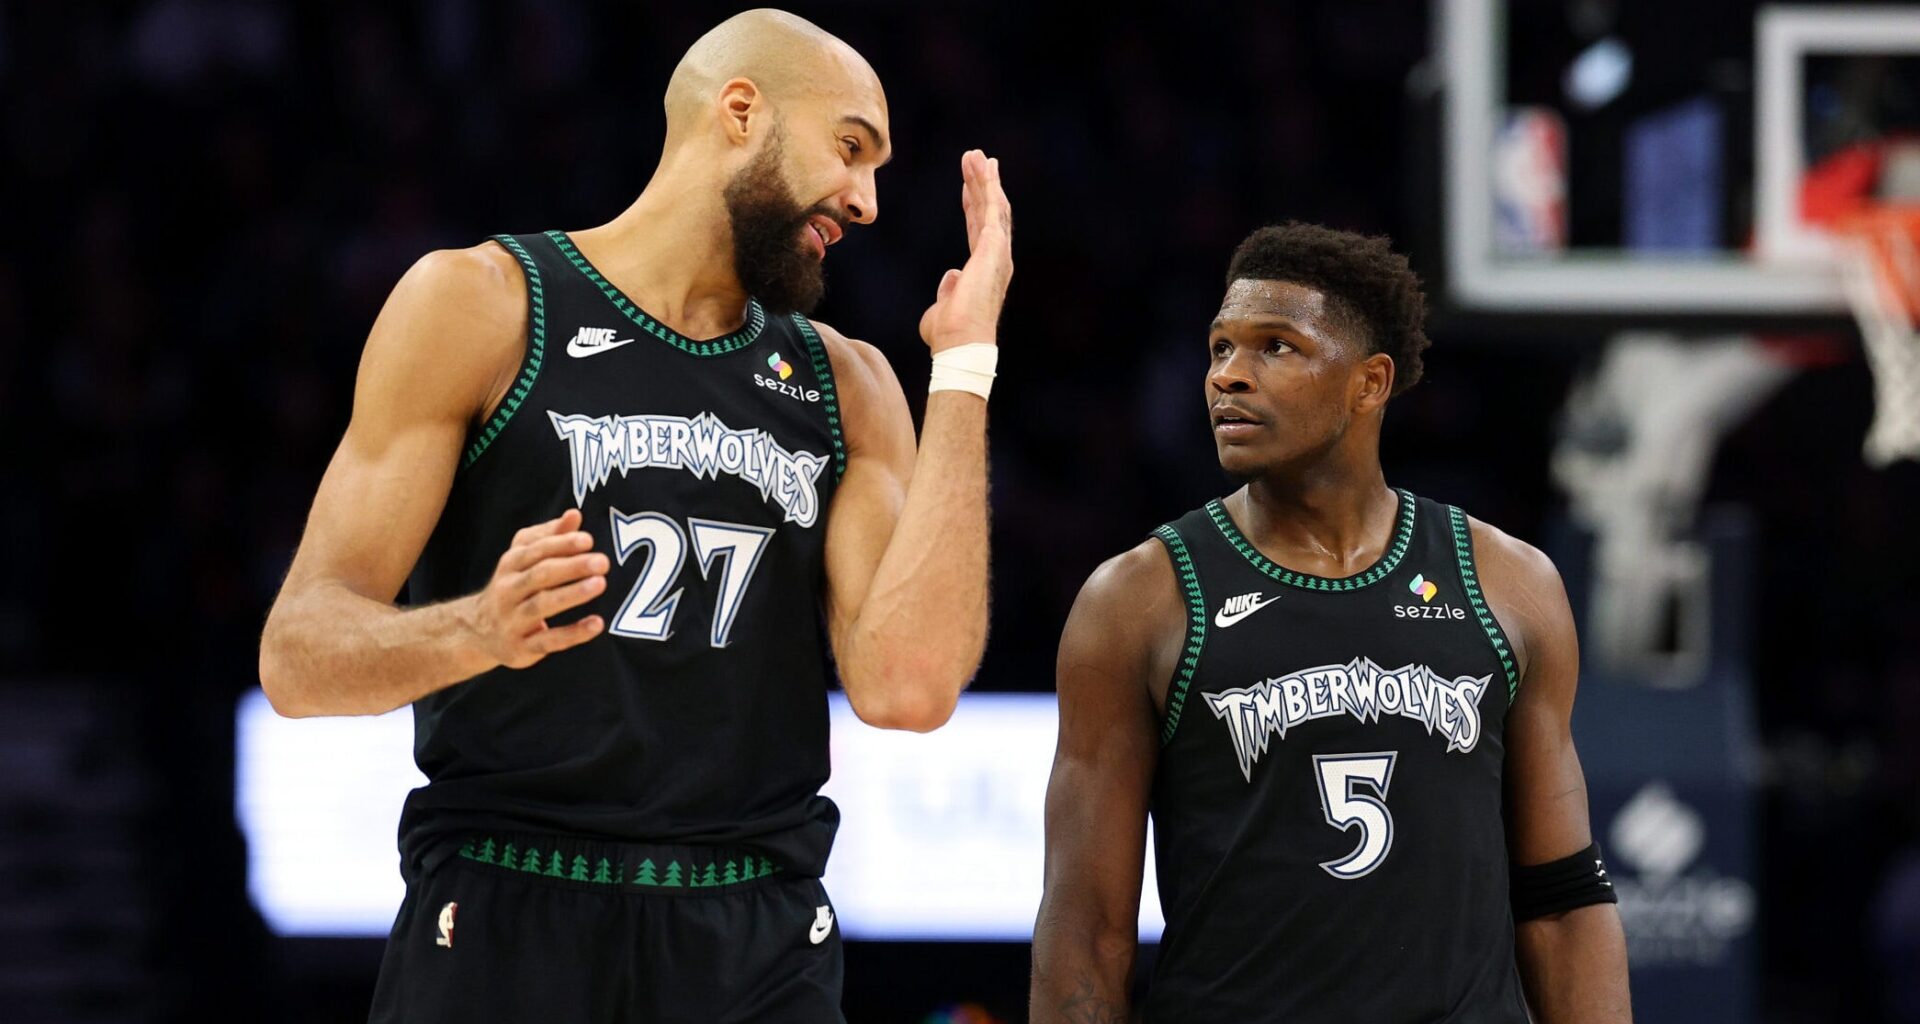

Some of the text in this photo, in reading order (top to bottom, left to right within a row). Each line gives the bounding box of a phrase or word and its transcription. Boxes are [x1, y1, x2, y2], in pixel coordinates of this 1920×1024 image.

[576, 326, 617, 346] NIKE
[753, 373, 821, 402] sezzle
[546, 410, 830, 528] TIMBERWOLVES
[608, 506, 776, 648] 27
[1223, 592, 1263, 615] NIKE
[1393, 602, 1466, 620] sezzle
[1200, 656, 1494, 783] TIMBERWOLVES
[1312, 751, 1398, 879] 5
